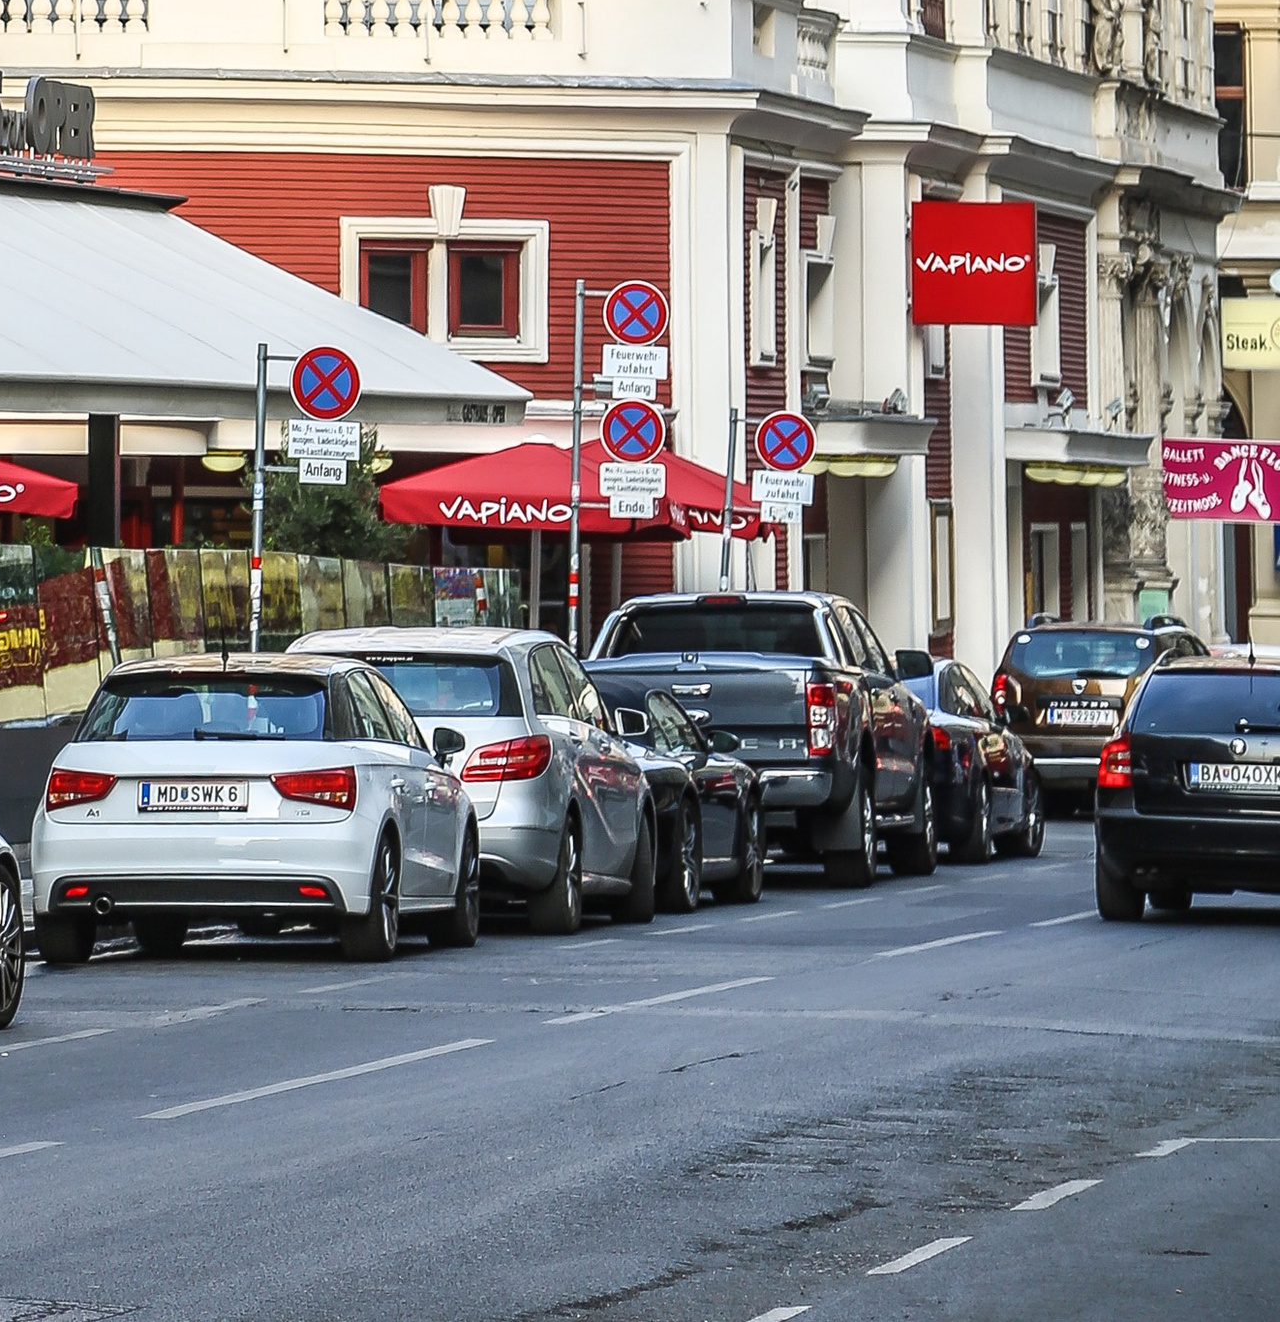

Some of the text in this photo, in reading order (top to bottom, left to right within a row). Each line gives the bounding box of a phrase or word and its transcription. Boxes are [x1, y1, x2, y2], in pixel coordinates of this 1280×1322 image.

[25, 76, 95, 159] OPER
[611, 349, 661, 361] Feuerwehr-
[617, 363, 653, 375] zufahrt
[618, 381, 651, 396] Anfang
[1214, 444, 1259, 471] DANCE
[305, 462, 341, 481] Anfang
[766, 488, 799, 501] zufahrt
[618, 500, 645, 513] Ende
[1201, 764, 1221, 782] BA
[157, 786, 178, 803] MD
[191, 786, 224, 803] SWK
[228, 786, 238, 802] 6
[86, 808, 100, 817] A1
